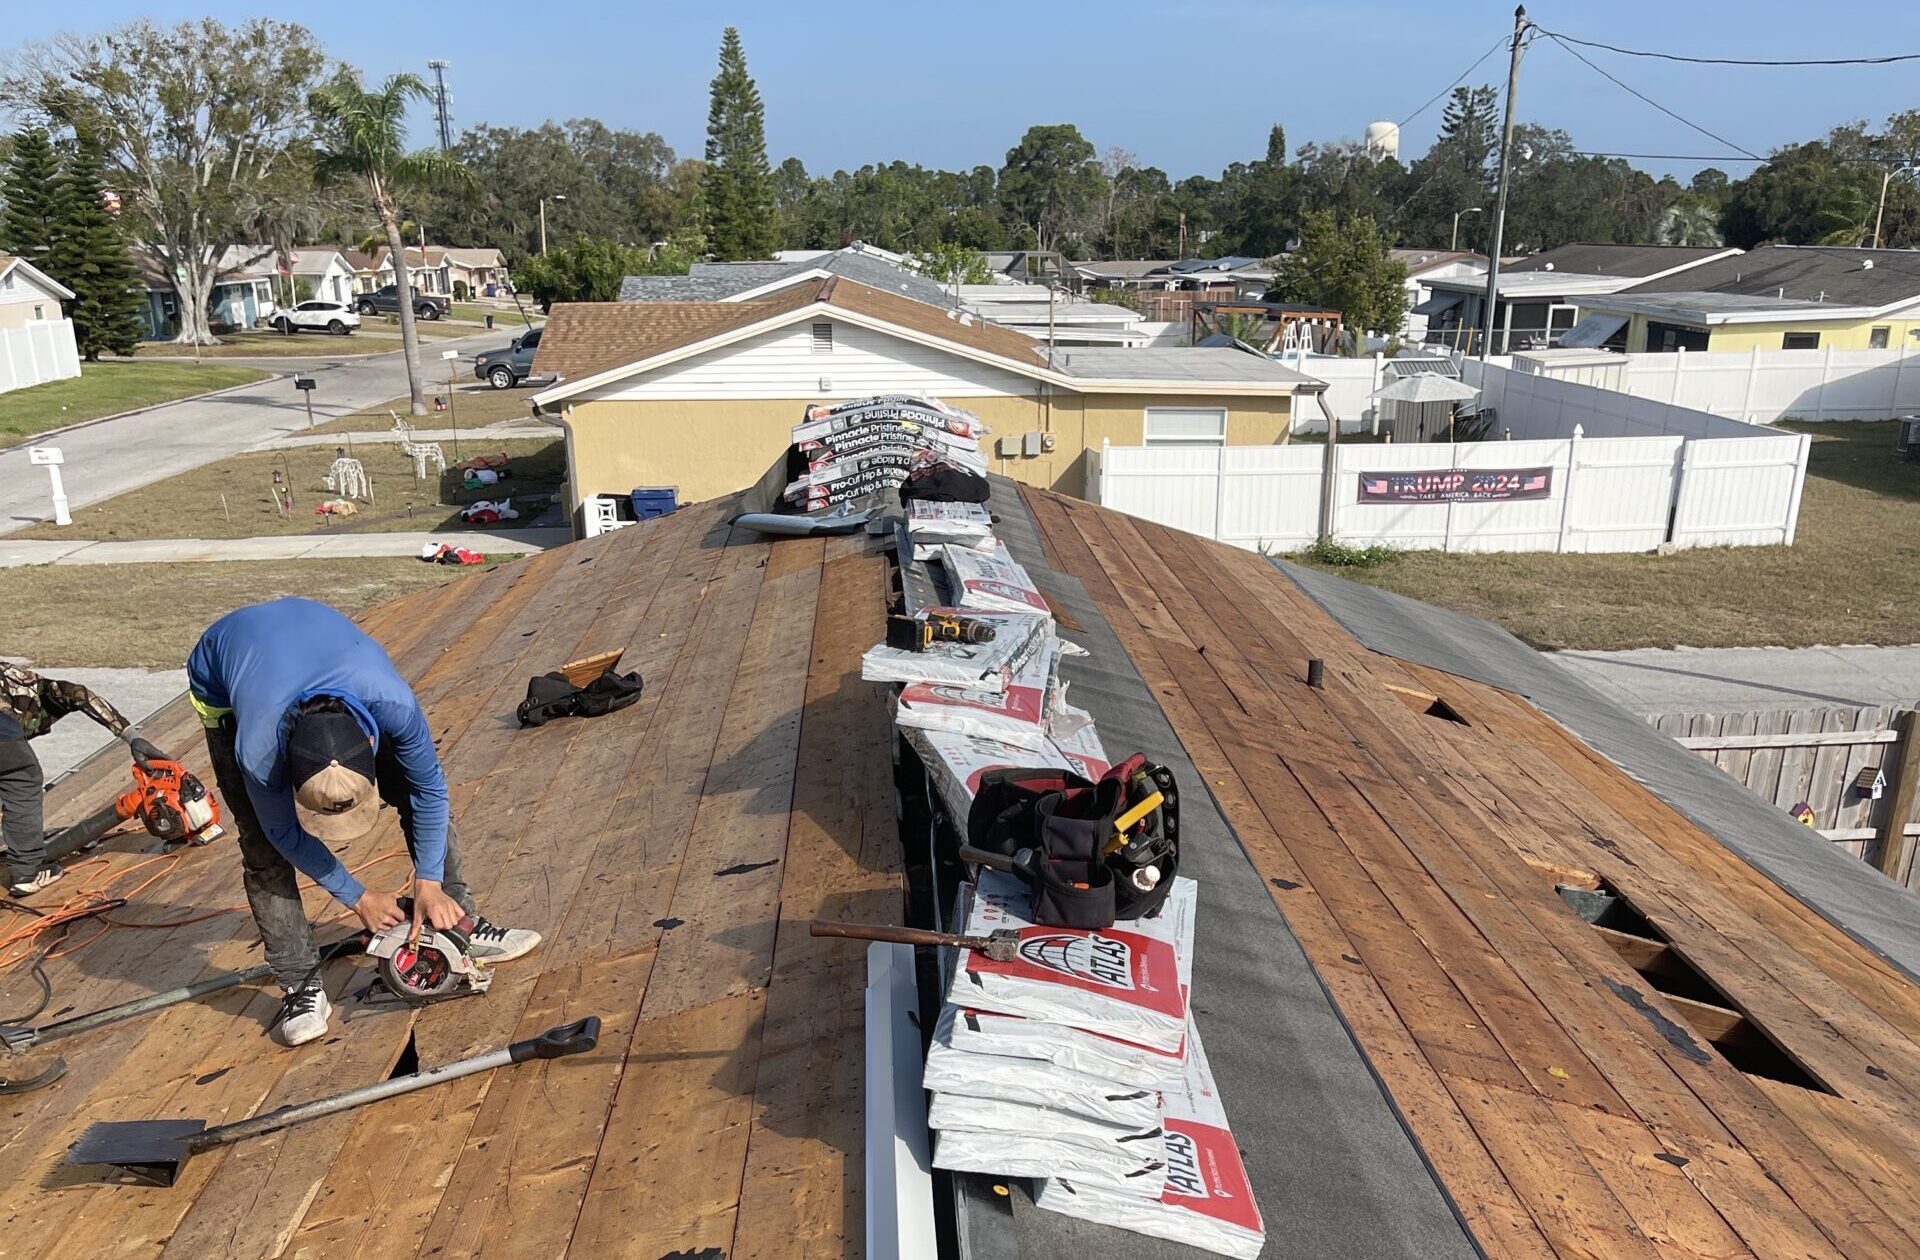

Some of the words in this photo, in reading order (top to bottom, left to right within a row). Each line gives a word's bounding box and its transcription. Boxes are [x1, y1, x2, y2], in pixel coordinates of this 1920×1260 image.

[864, 409, 898, 419] Pristine
[901, 410, 945, 428] Pinnacle
[825, 426, 870, 445] Pinnacle
[870, 423, 903, 433] Pristine
[835, 434, 879, 452] Pinnacle
[881, 432, 915, 443] Pristine
[872, 456, 896, 465] Ridge
[831, 475, 860, 491] Pro-Cut
[862, 471, 876, 481] Hip
[1391, 473, 1465, 493] TRUMP
[1472, 474, 1520, 491] 2024
[829, 487, 860, 503] Pro-Cut
[861, 482, 875, 493] Hip
[1091, 935, 1128, 986] ATLAS
[1164, 1133, 1203, 1195] ATLAS
